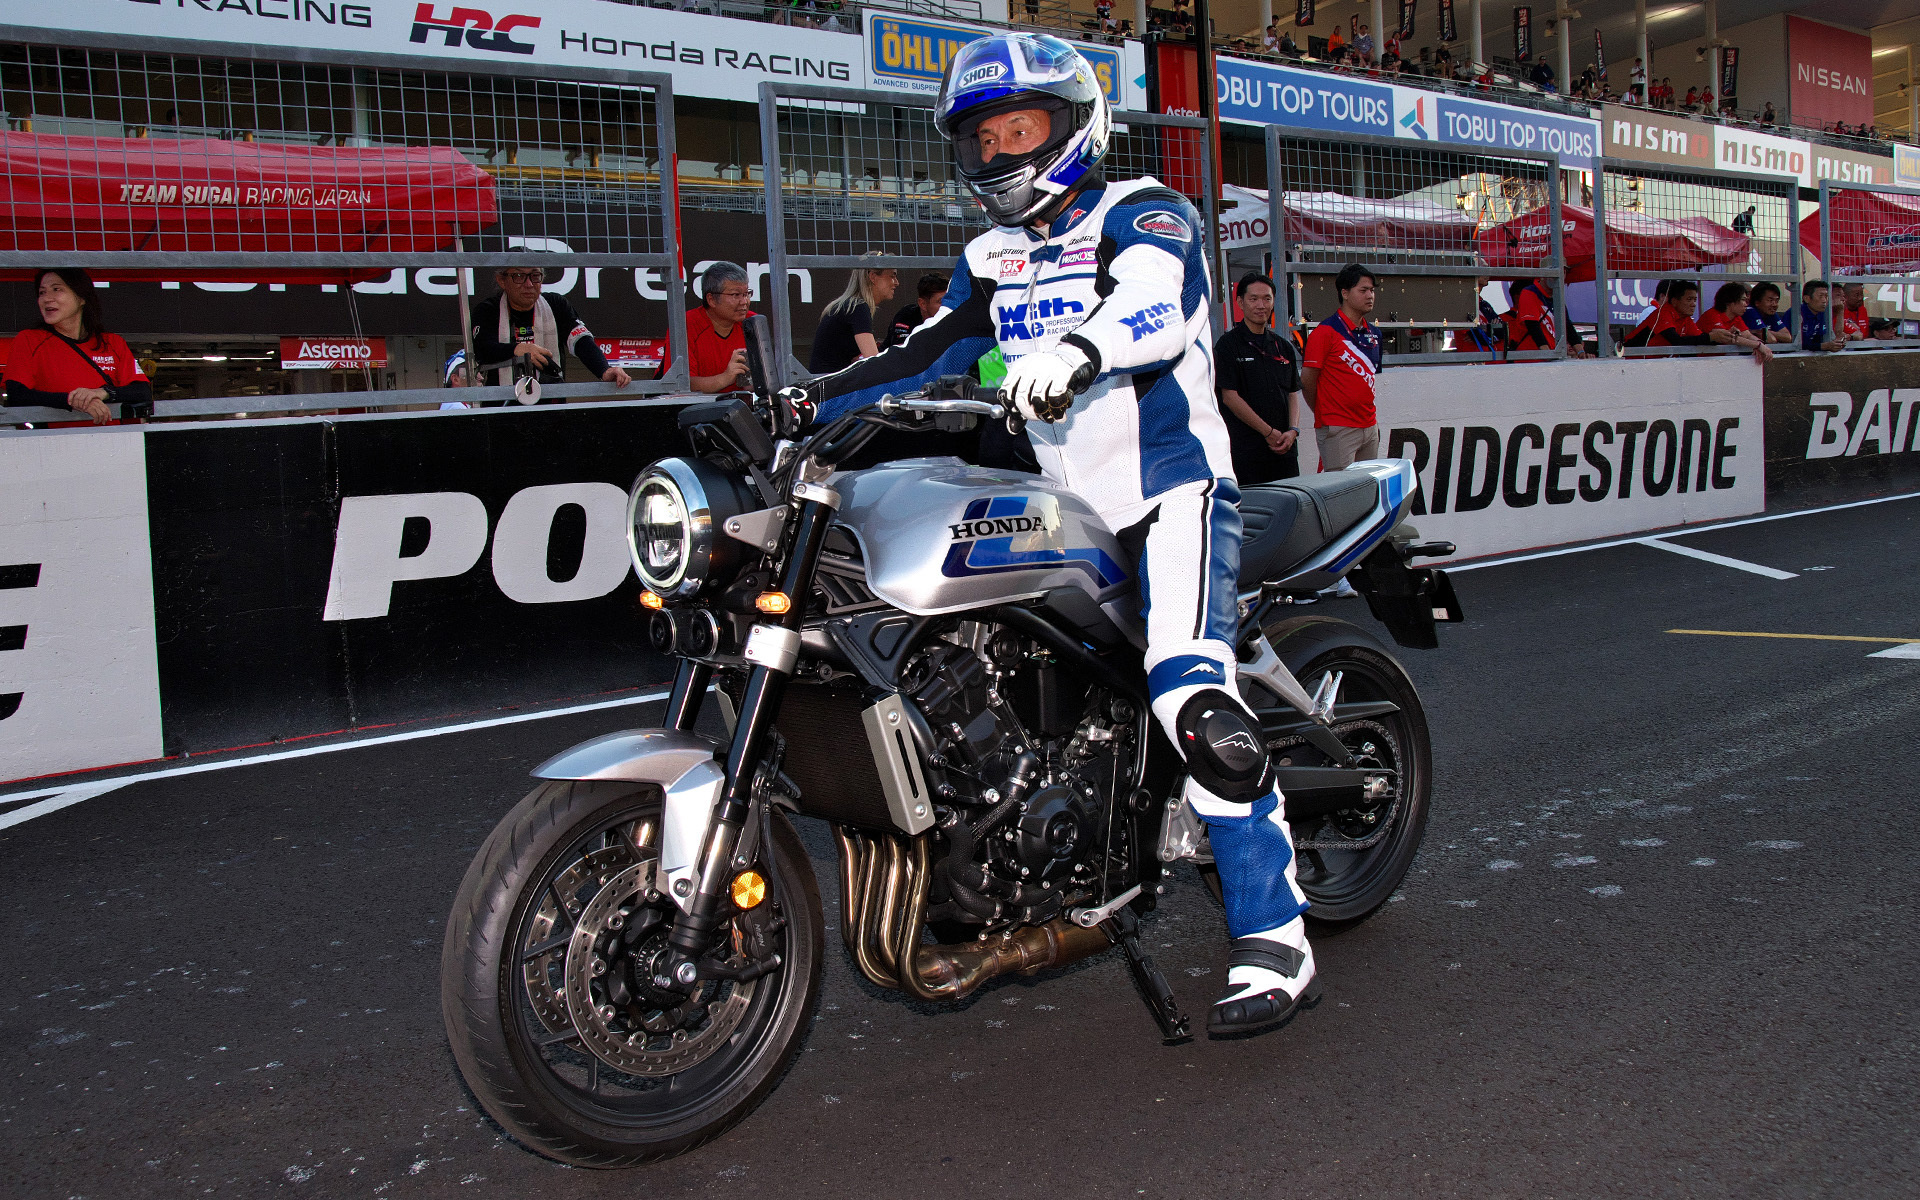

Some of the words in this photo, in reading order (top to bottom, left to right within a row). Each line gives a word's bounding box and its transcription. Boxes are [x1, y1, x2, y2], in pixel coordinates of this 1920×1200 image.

[409, 3, 541, 55] HRC
[560, 30, 704, 65] Honda
[715, 47, 850, 81] RACING
[873, 78, 909, 88] ADVANCED
[963, 65, 998, 87] SHOEI
[1798, 63, 1866, 96] NISSAN
[1217, 77, 1261, 108] OBU
[1268, 82, 1314, 115] TOP
[1318, 90, 1388, 126] TOURS
[1445, 111, 1496, 143] TOBU
[1500, 120, 1536, 148] TOP
[1538, 126, 1593, 158] TOURS
[1612, 120, 1709, 159] nismo
[1723, 139, 1804, 174] nismo
[1816, 156, 1889, 184] nismo
[120, 184, 177, 203] TEAM
[182, 185, 241, 205] SUGAI
[246, 187, 311, 205] RACING
[315, 189, 371, 206] JAPAN
[1520, 220, 1576, 239] Hona
[507, 236, 813, 304] Drem
[997, 297, 1084, 324] With
[1046, 316, 1085, 327] PROFESSIONAL
[1117, 302, 1177, 328] With
[1612, 311, 1642, 321] TECH
[1046, 327, 1070, 336] RACING
[298, 342, 371, 359] Astemo
[1410, 340, 1421, 351] 38
[1806, 388, 1920, 460] BAT
[1378, 417, 1740, 517] RIDGESTONE
[948, 516, 1047, 540] HONDA
